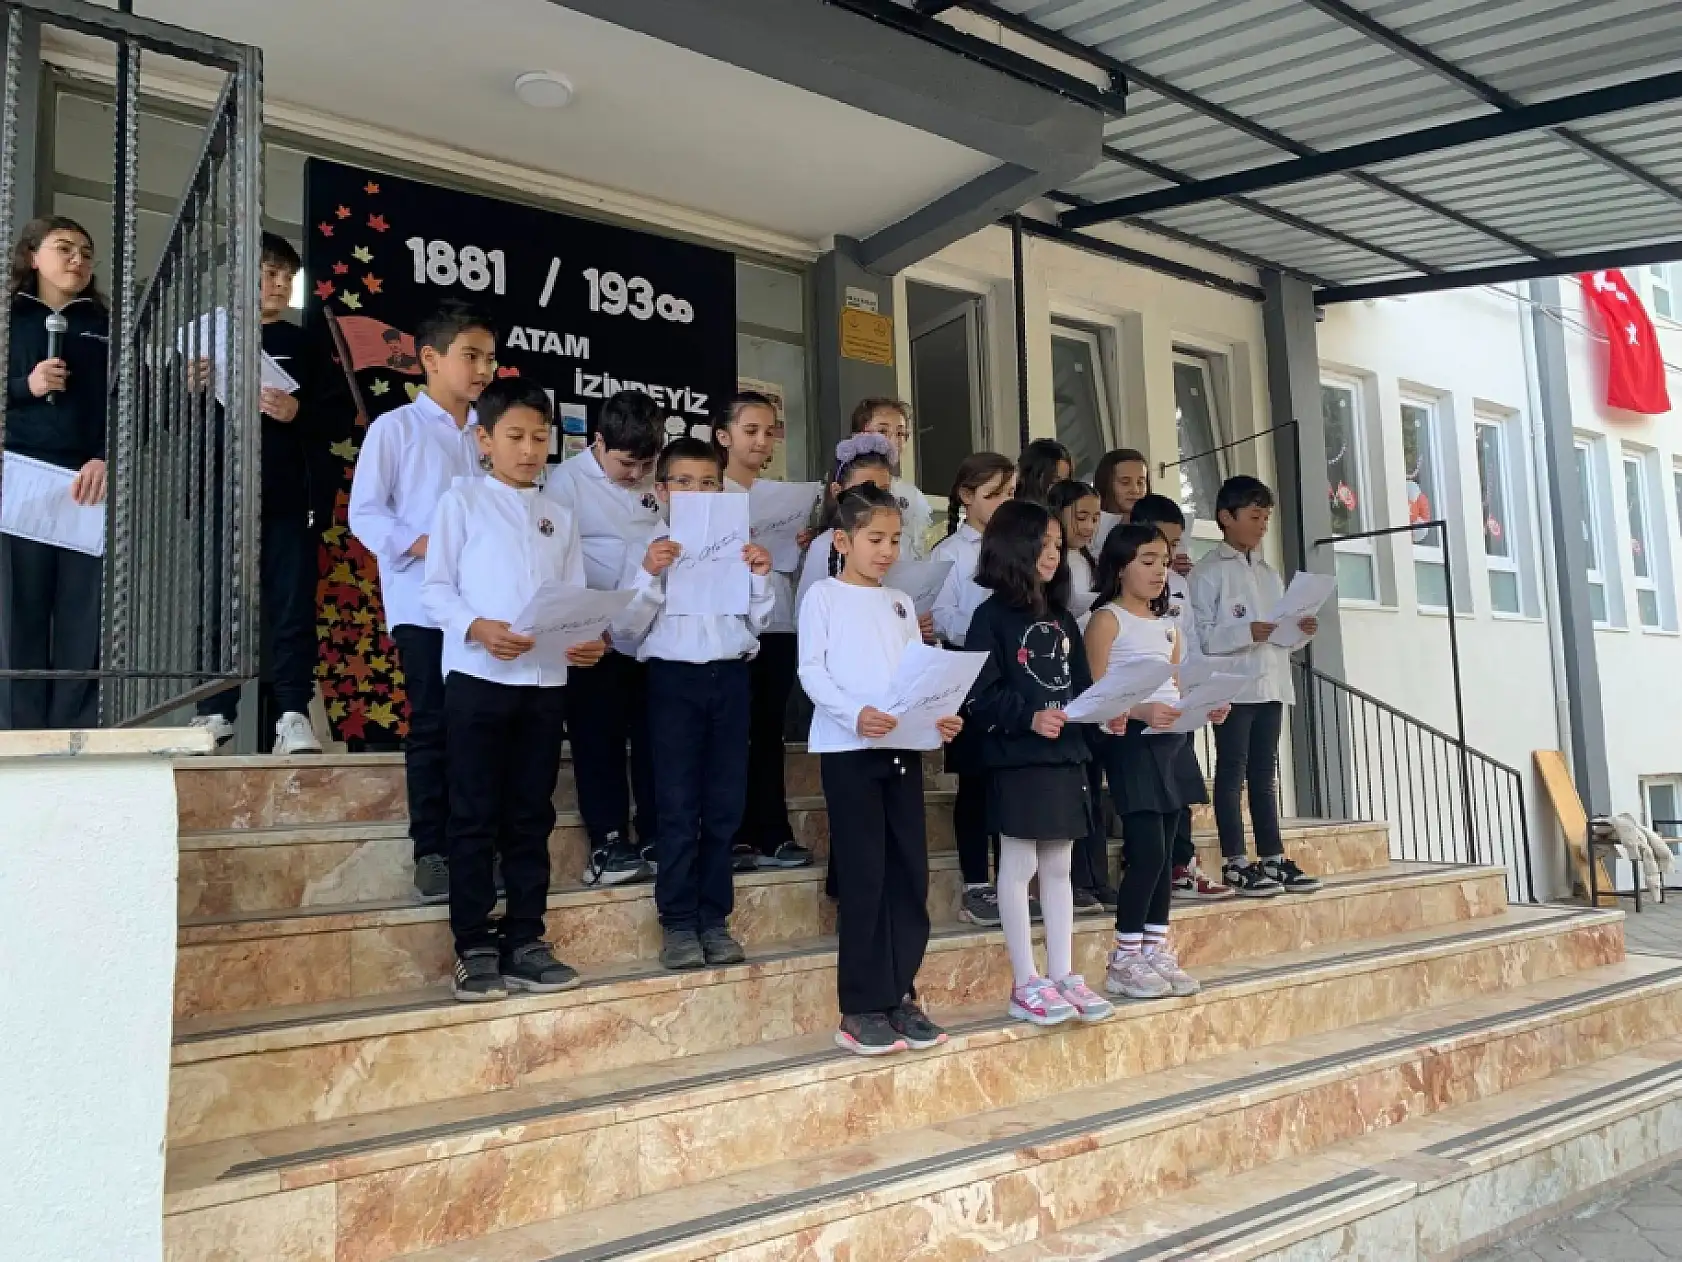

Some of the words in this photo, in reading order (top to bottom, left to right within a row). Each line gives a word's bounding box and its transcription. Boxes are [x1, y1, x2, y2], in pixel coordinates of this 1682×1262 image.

[405, 236, 506, 295] 1881
[539, 256, 561, 307] /
[506, 325, 590, 359] ATAM
